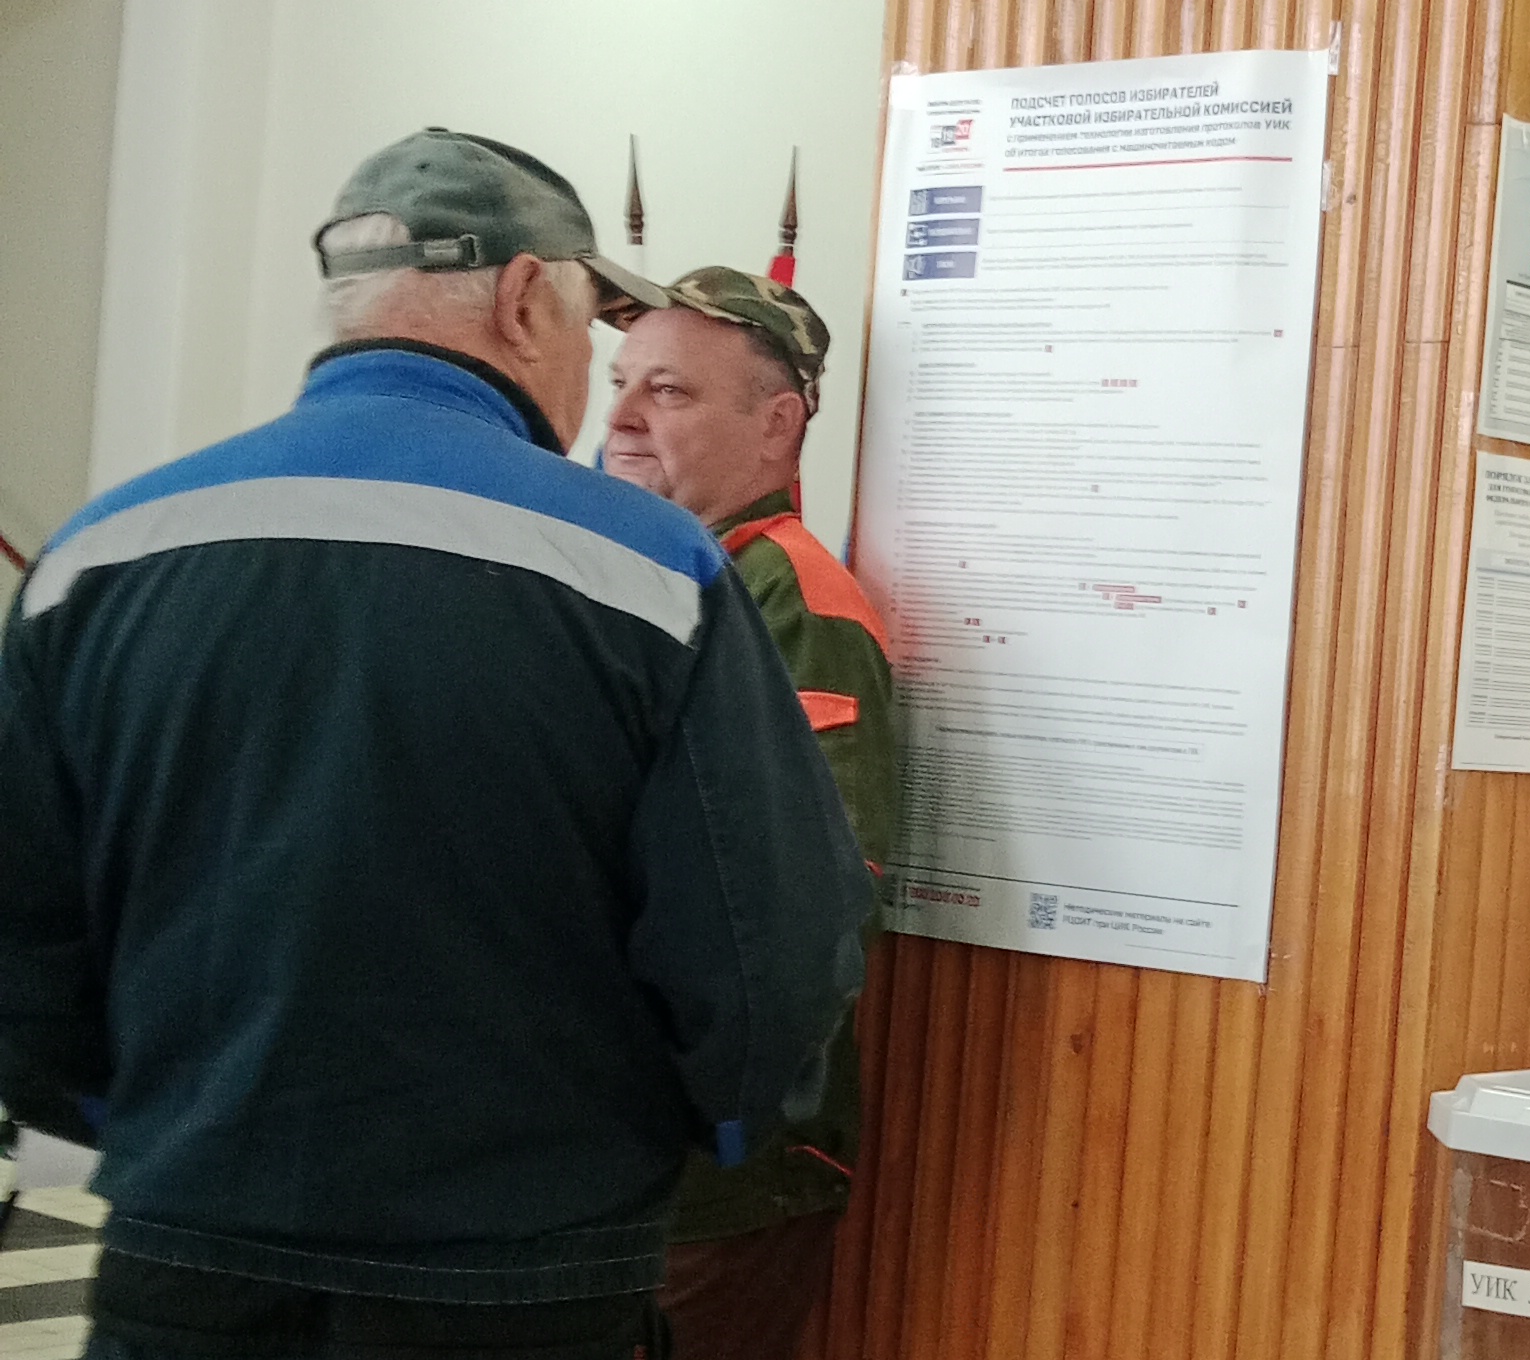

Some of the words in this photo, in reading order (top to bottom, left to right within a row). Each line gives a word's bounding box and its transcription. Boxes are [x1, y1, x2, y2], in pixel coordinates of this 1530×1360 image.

[1011, 94, 1066, 110] ПОДСЧЕТ
[1069, 89, 1126, 107] ГОЛОСОВ
[1130, 81, 1219, 103] ИЗБИРАТЕЛЕЙ
[1009, 110, 1092, 128] УЧАСТКОВОЙ
[1093, 102, 1200, 124] ИЗБИРАТЕЛЬНОЙ
[1203, 97, 1293, 116] КОМИССИЕЙ
[1264, 119, 1291, 131] УИК
[1470, 1273, 1518, 1302] УИК
